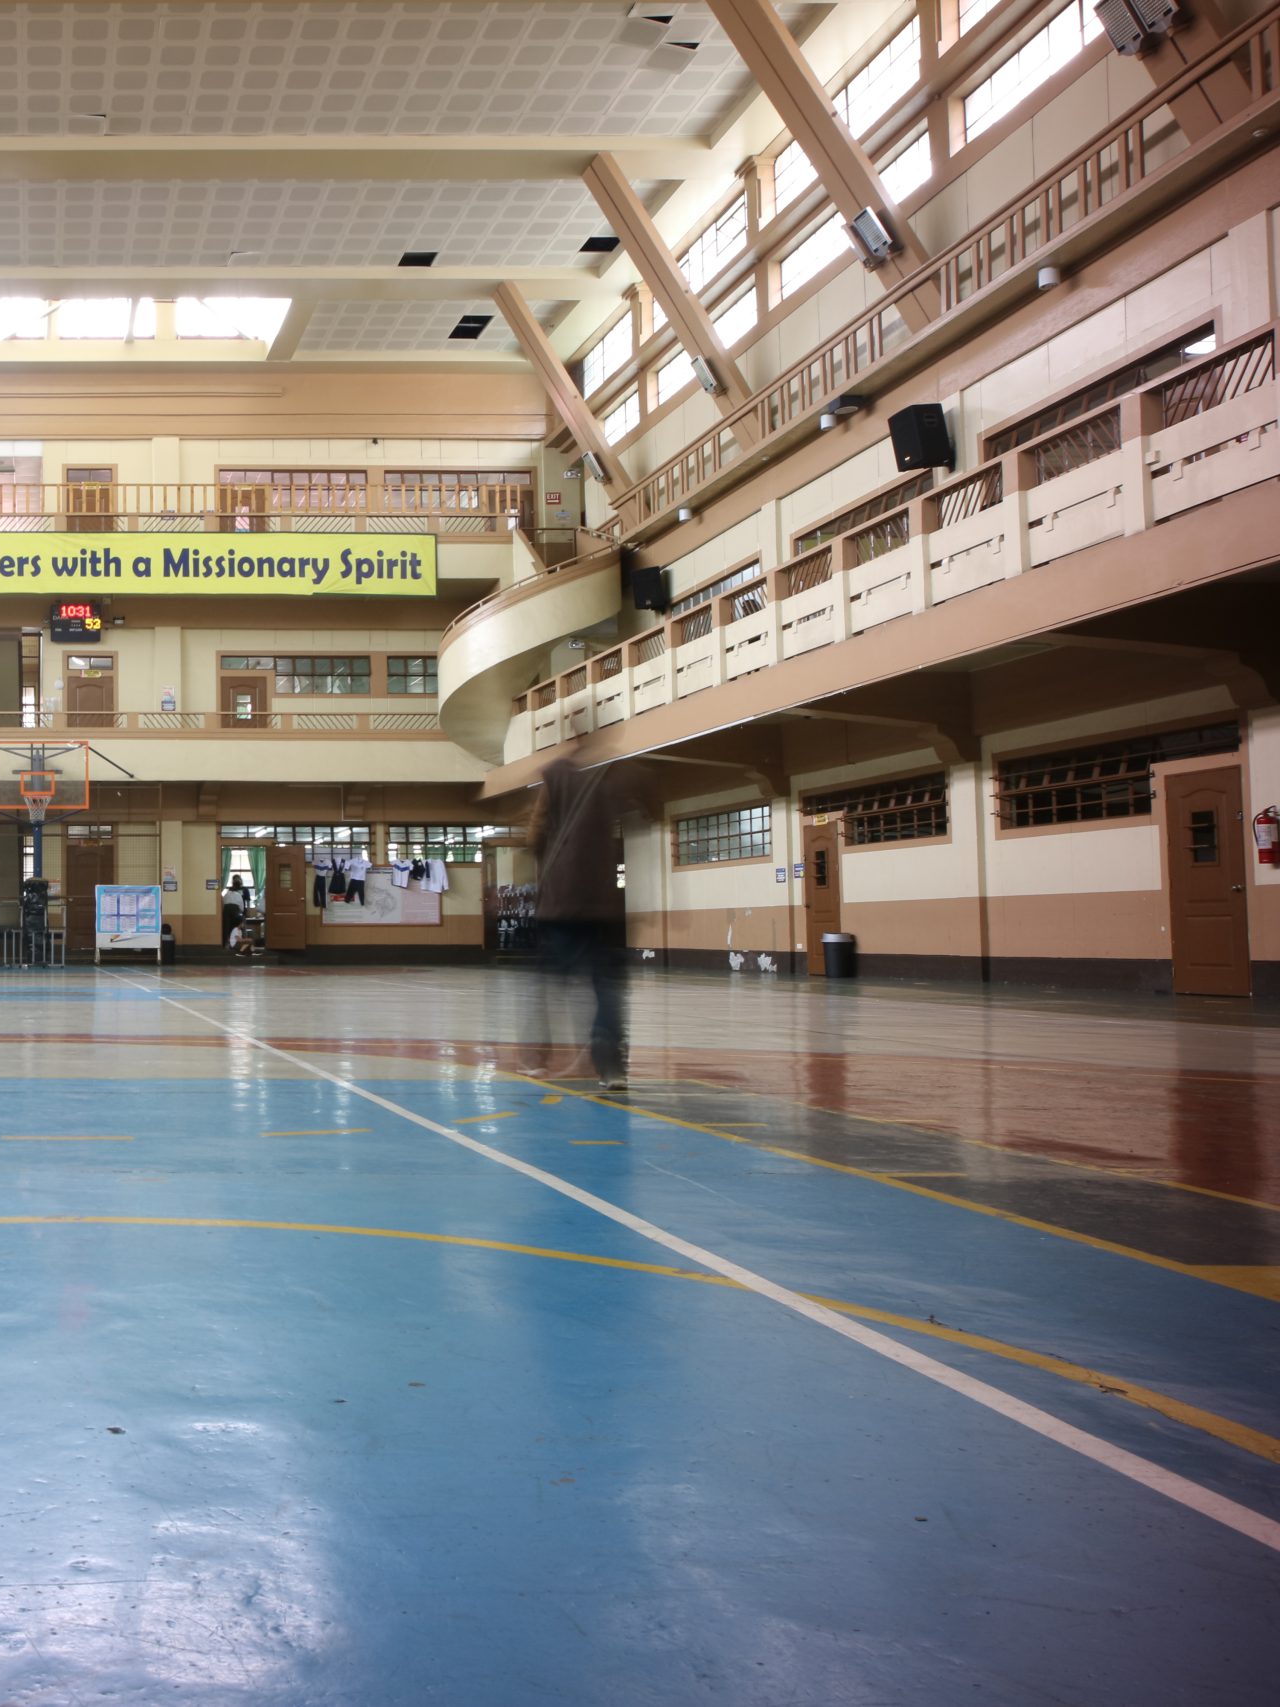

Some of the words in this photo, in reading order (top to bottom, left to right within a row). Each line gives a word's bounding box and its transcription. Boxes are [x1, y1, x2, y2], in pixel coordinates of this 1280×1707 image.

[52, 548, 122, 577] with
[132, 556, 152, 577] a
[163, 547, 330, 585] Missionary
[340, 547, 422, 585] Spirit
